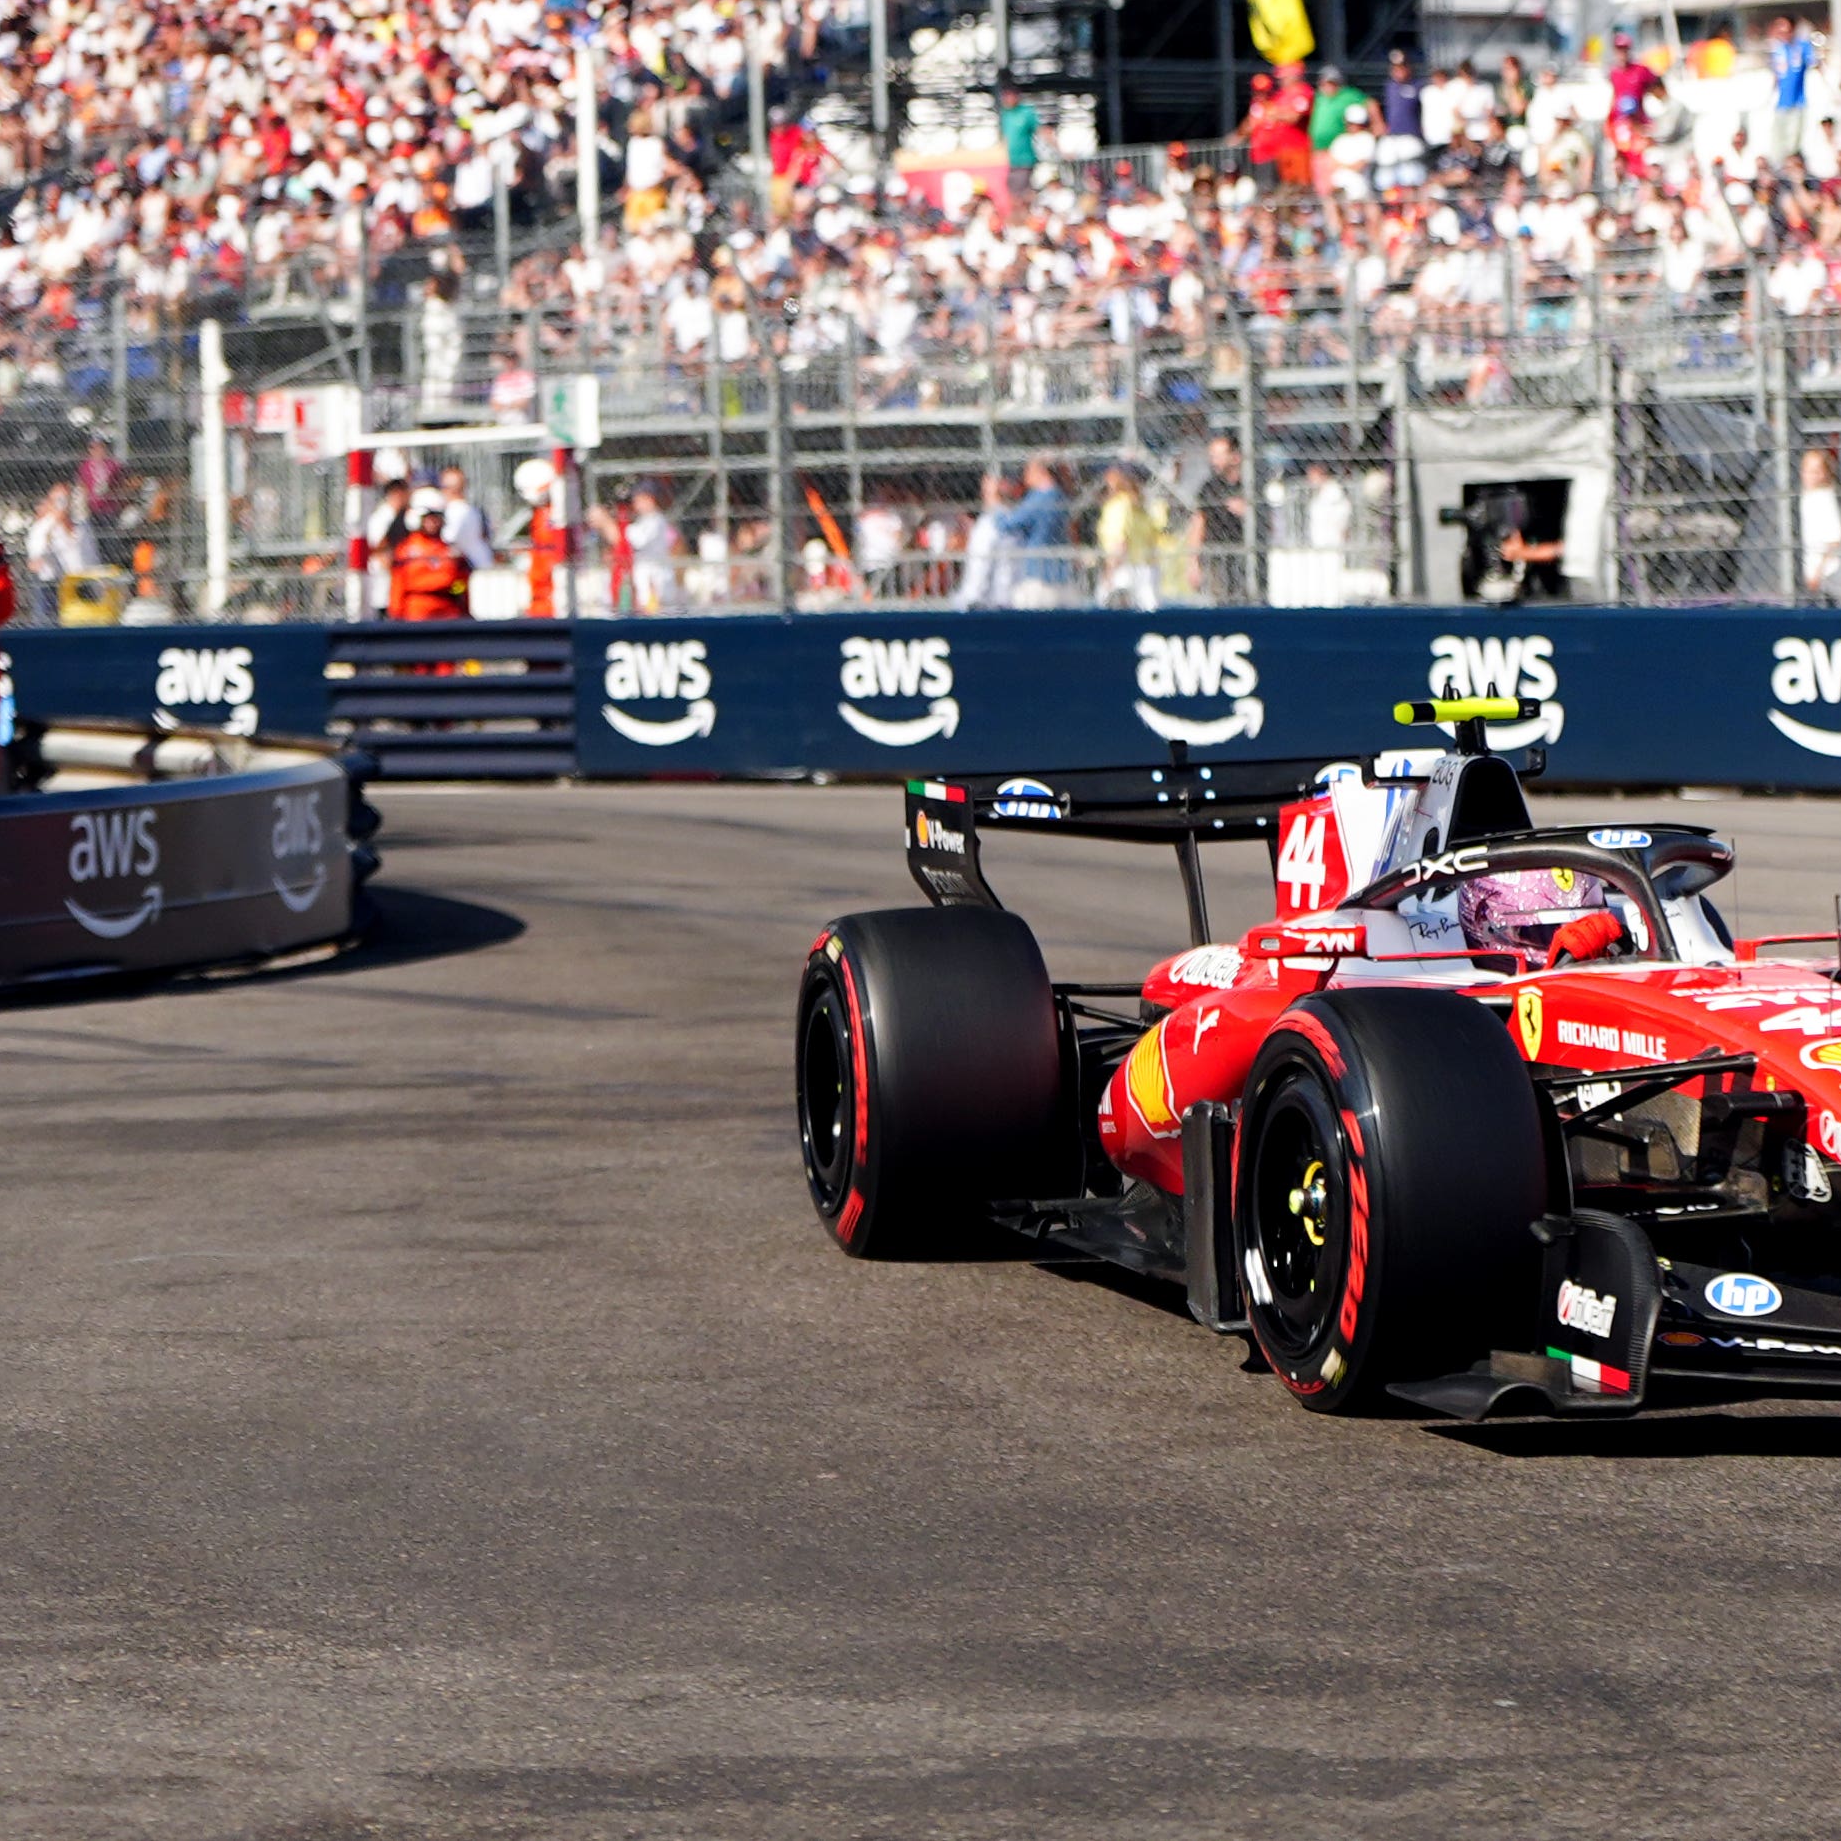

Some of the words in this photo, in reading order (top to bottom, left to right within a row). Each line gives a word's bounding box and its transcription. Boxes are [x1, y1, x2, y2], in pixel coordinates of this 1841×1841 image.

[155, 647, 254, 706] aws
[605, 640, 712, 700] aws
[840, 636, 953, 699] aws
[1136, 633, 1258, 698] aws
[1428, 634, 1558, 705] aws
[68, 807, 160, 882] aws
[272, 789, 323, 861] aws
[1277, 814, 1327, 910] 44
[1304, 932, 1357, 952] ZYN
[1556, 1019, 1619, 1052] RICHARD
[1622, 1031, 1667, 1061] MILLE
[1719, 1275, 1770, 1315] hp
